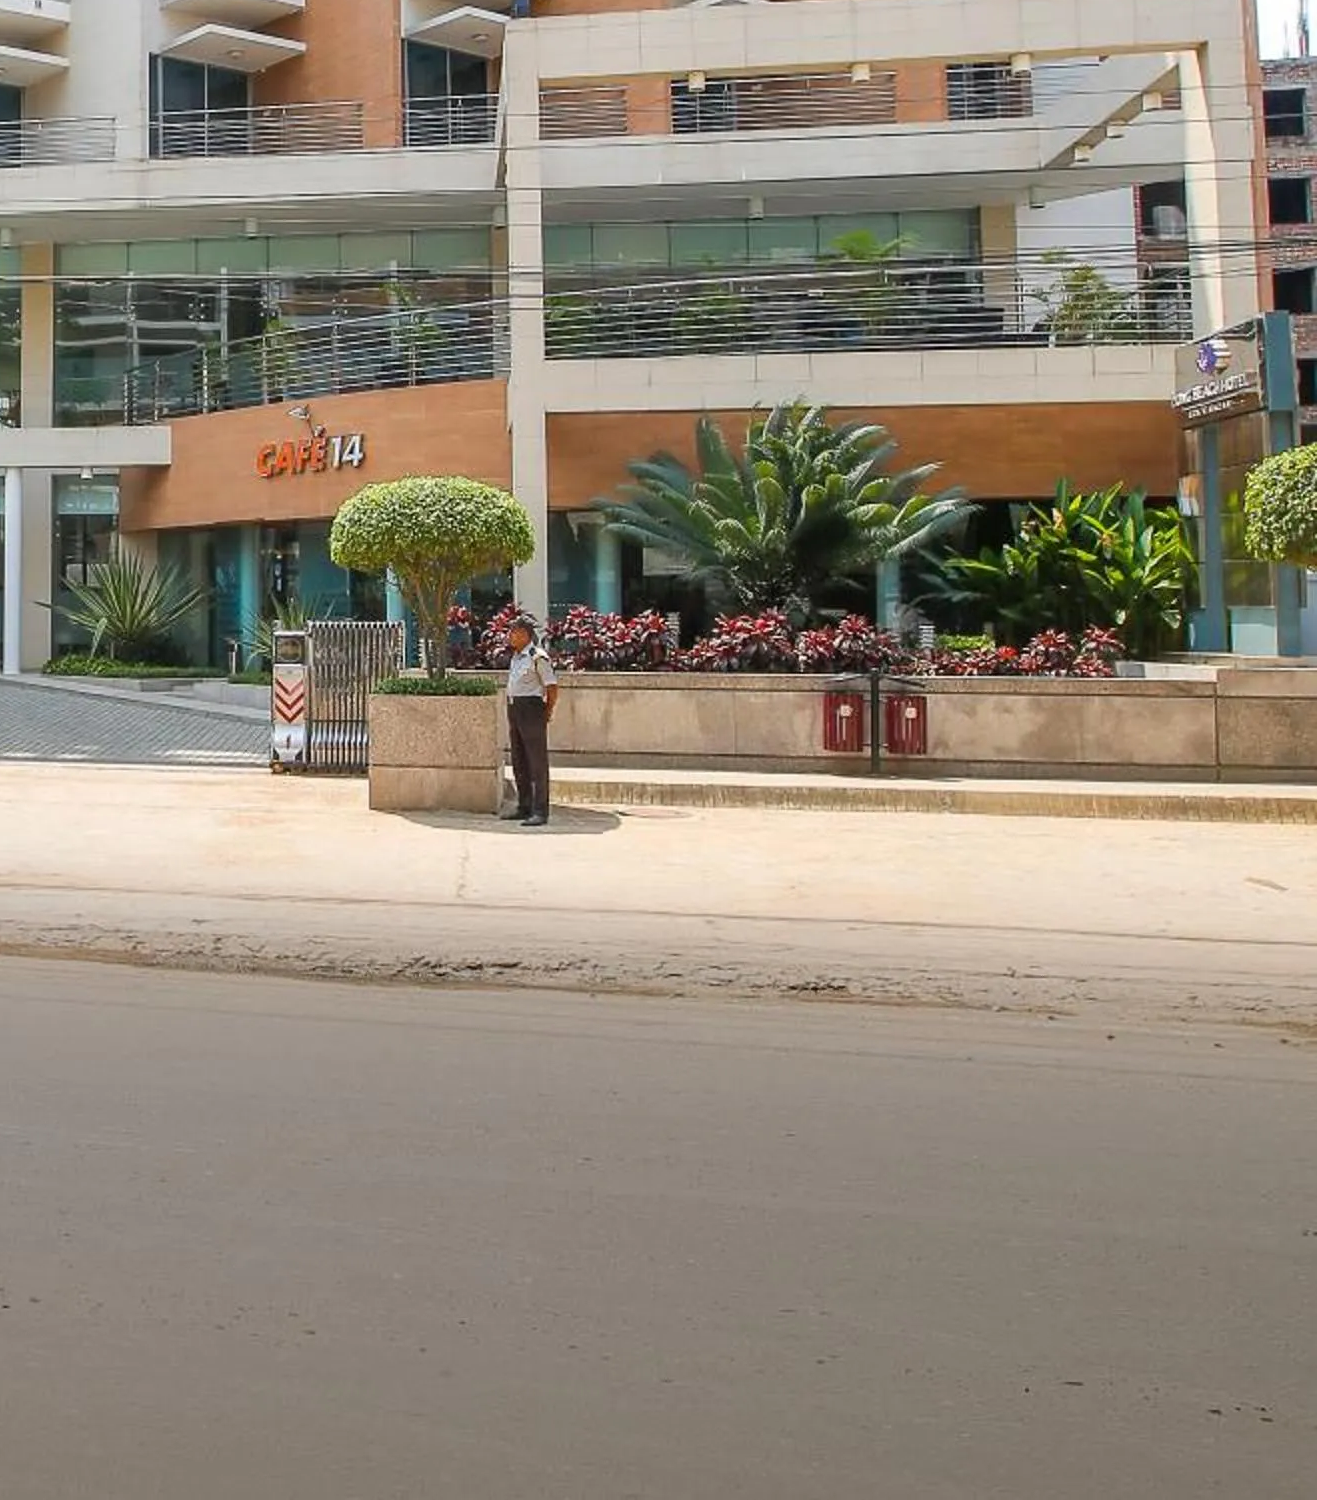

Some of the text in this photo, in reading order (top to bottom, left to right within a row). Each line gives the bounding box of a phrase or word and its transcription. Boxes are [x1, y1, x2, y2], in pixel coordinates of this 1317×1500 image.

[1192, 380, 1220, 401] BEACH
[1221, 373, 1248, 393] HOTEL
[331, 434, 365, 470] 14
